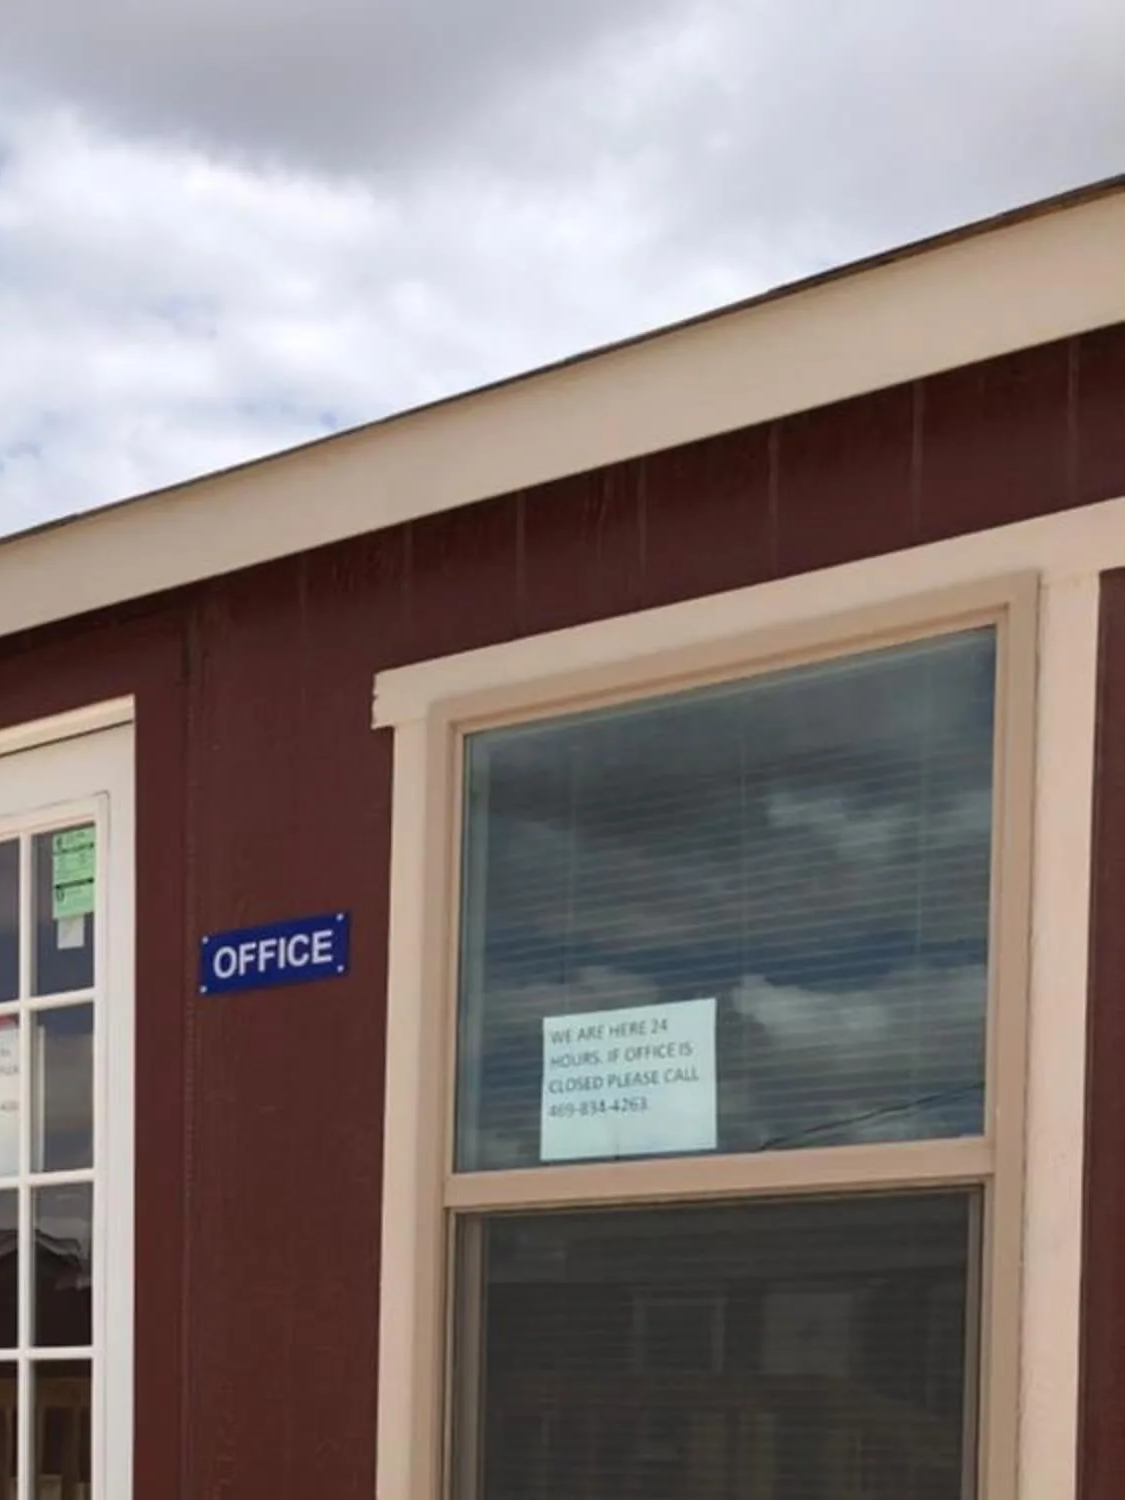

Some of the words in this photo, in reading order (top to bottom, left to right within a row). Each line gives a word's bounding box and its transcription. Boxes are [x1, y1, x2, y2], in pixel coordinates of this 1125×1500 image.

[212, 929, 333, 979] OFFICE
[549, 1029, 572, 1045] WE
[577, 1025, 605, 1041] ARE
[609, 1020, 647, 1038] HERE
[650, 1018, 668, 1035] 24
[607, 1048, 620, 1063] IF
[624, 1042, 676, 1062] OFFICE
[679, 1040, 694, 1057] IS
[548, 1075, 604, 1095] CLOSED
[607, 1070, 659, 1089] PLEASE
[663, 1065, 699, 1082] CALL
